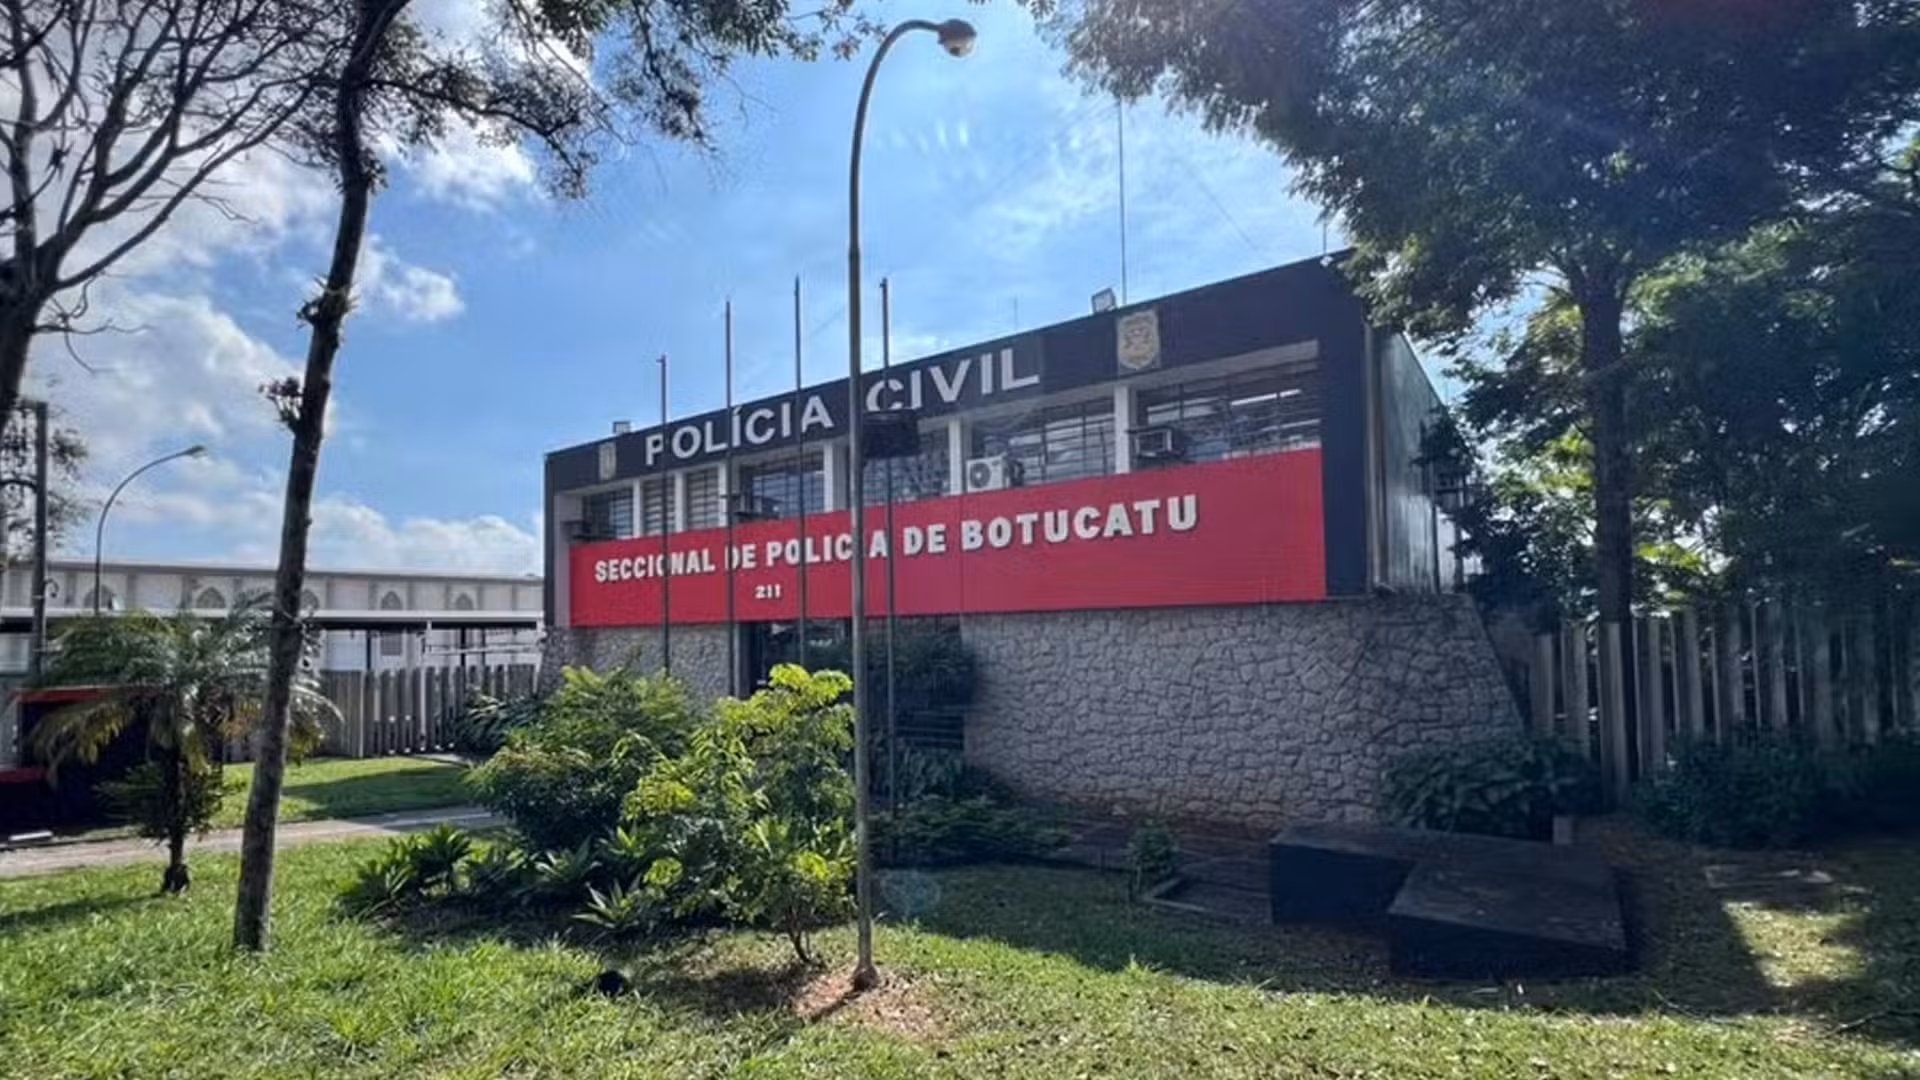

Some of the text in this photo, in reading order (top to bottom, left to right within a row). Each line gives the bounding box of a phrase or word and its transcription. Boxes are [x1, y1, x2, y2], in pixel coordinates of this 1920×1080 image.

[645, 348, 1040, 466] POLÍCIA CIVIL
[594, 494, 1197, 582] SECCIONAL DE POLICA DE BOTUCATU
[755, 583, 782, 599] 211
